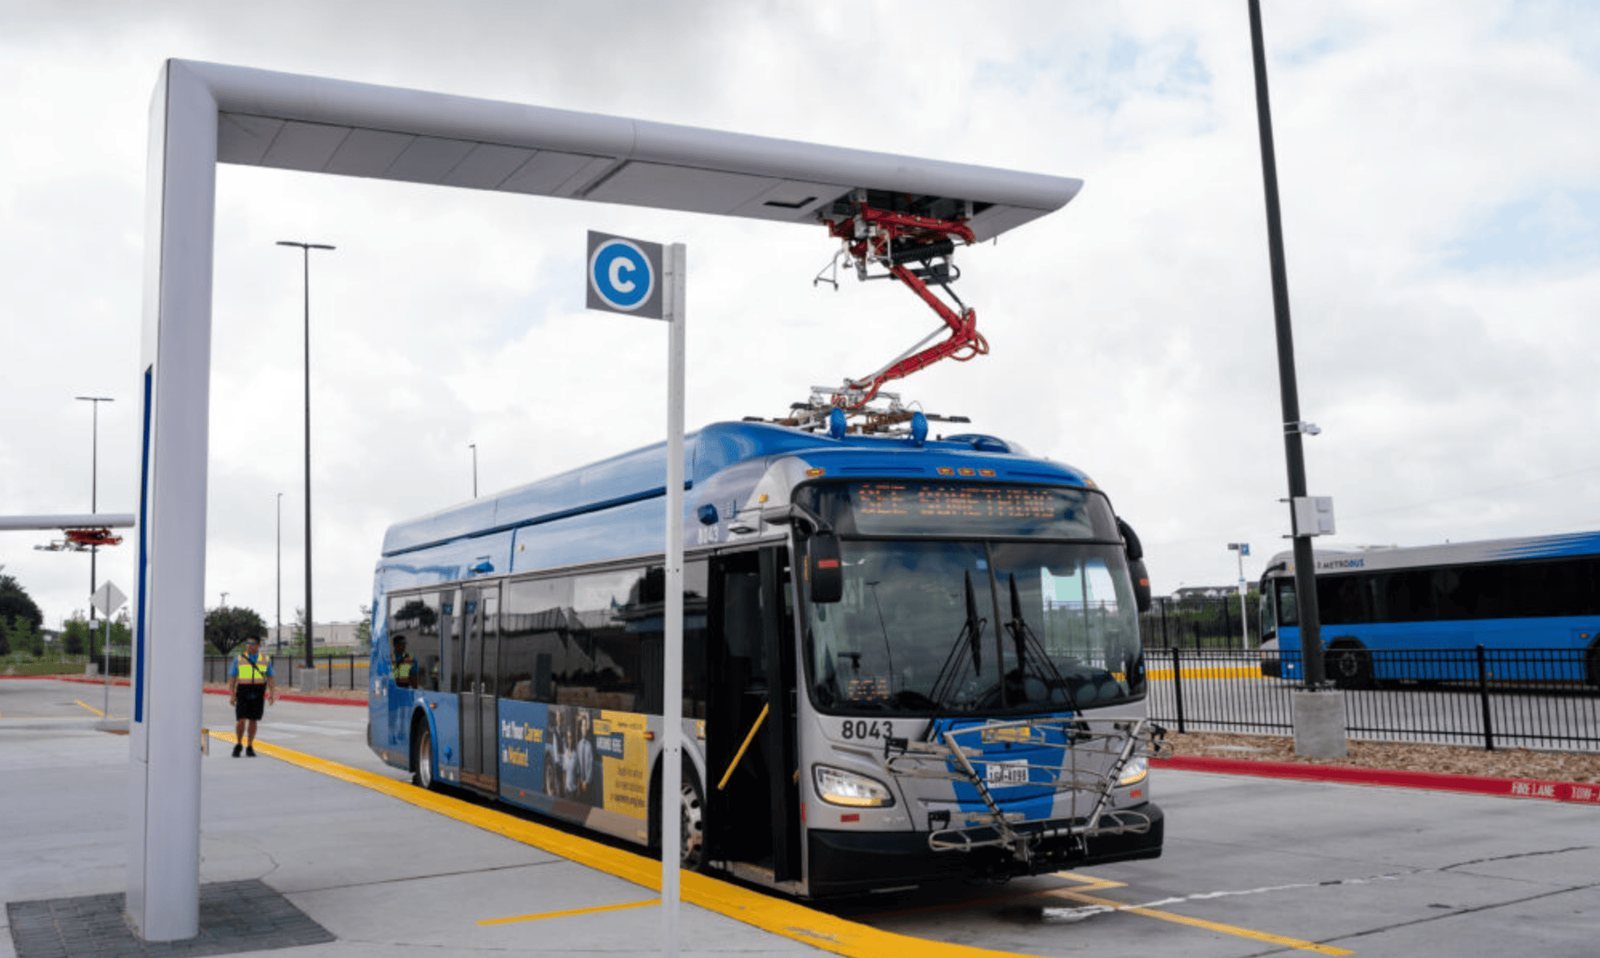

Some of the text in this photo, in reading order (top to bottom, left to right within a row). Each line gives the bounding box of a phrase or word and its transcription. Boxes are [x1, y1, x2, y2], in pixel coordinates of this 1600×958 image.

[608, 256, 636, 293] C
[918, 486, 1056, 518] SOMETHING
[841, 720, 893, 740] 8043
[1512, 781, 1531, 795] FIRE
[1532, 782, 1555, 797] LANE
